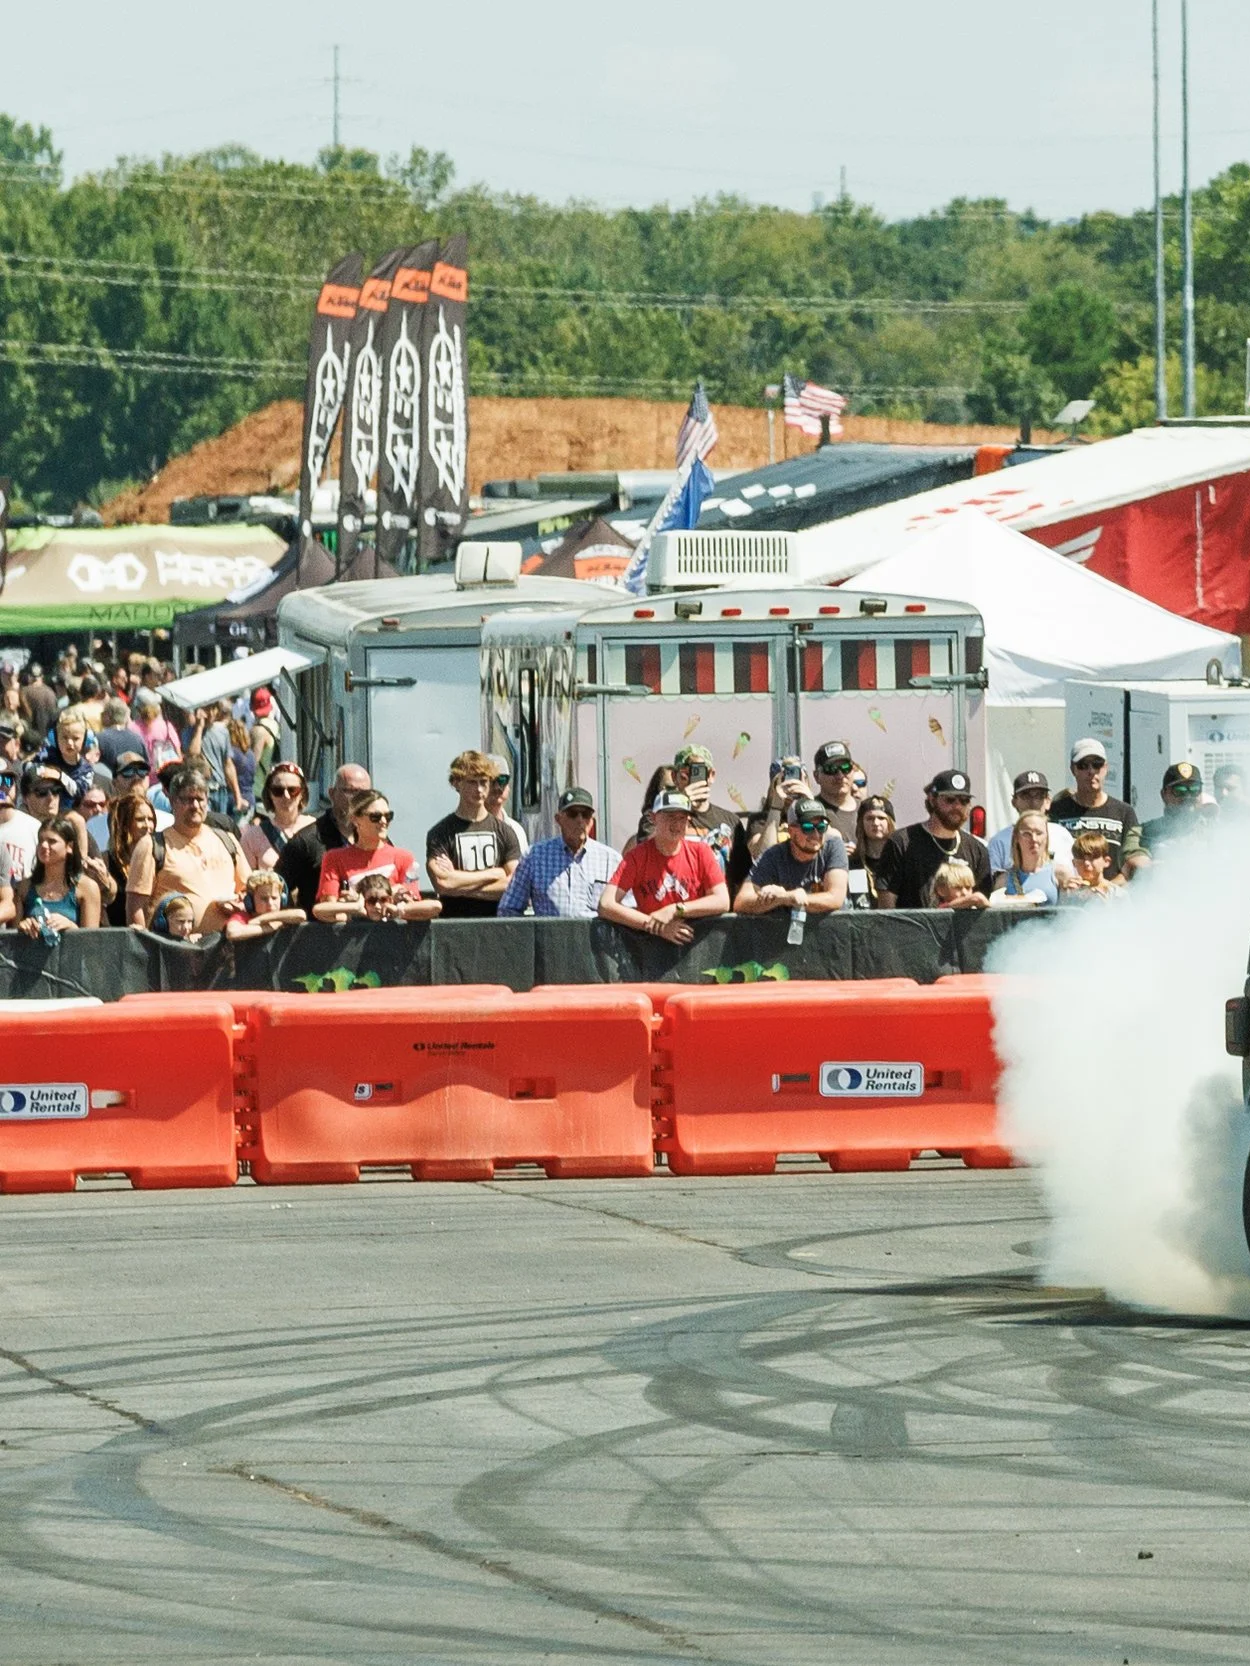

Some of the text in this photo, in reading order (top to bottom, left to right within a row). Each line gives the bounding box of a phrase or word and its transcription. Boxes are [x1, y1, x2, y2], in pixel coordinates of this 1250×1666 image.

[865, 1067, 913, 1080] United
[865, 1080, 917, 1091] Rentals
[30, 1089, 77, 1101] United
[30, 1101, 82, 1113] Rentals
